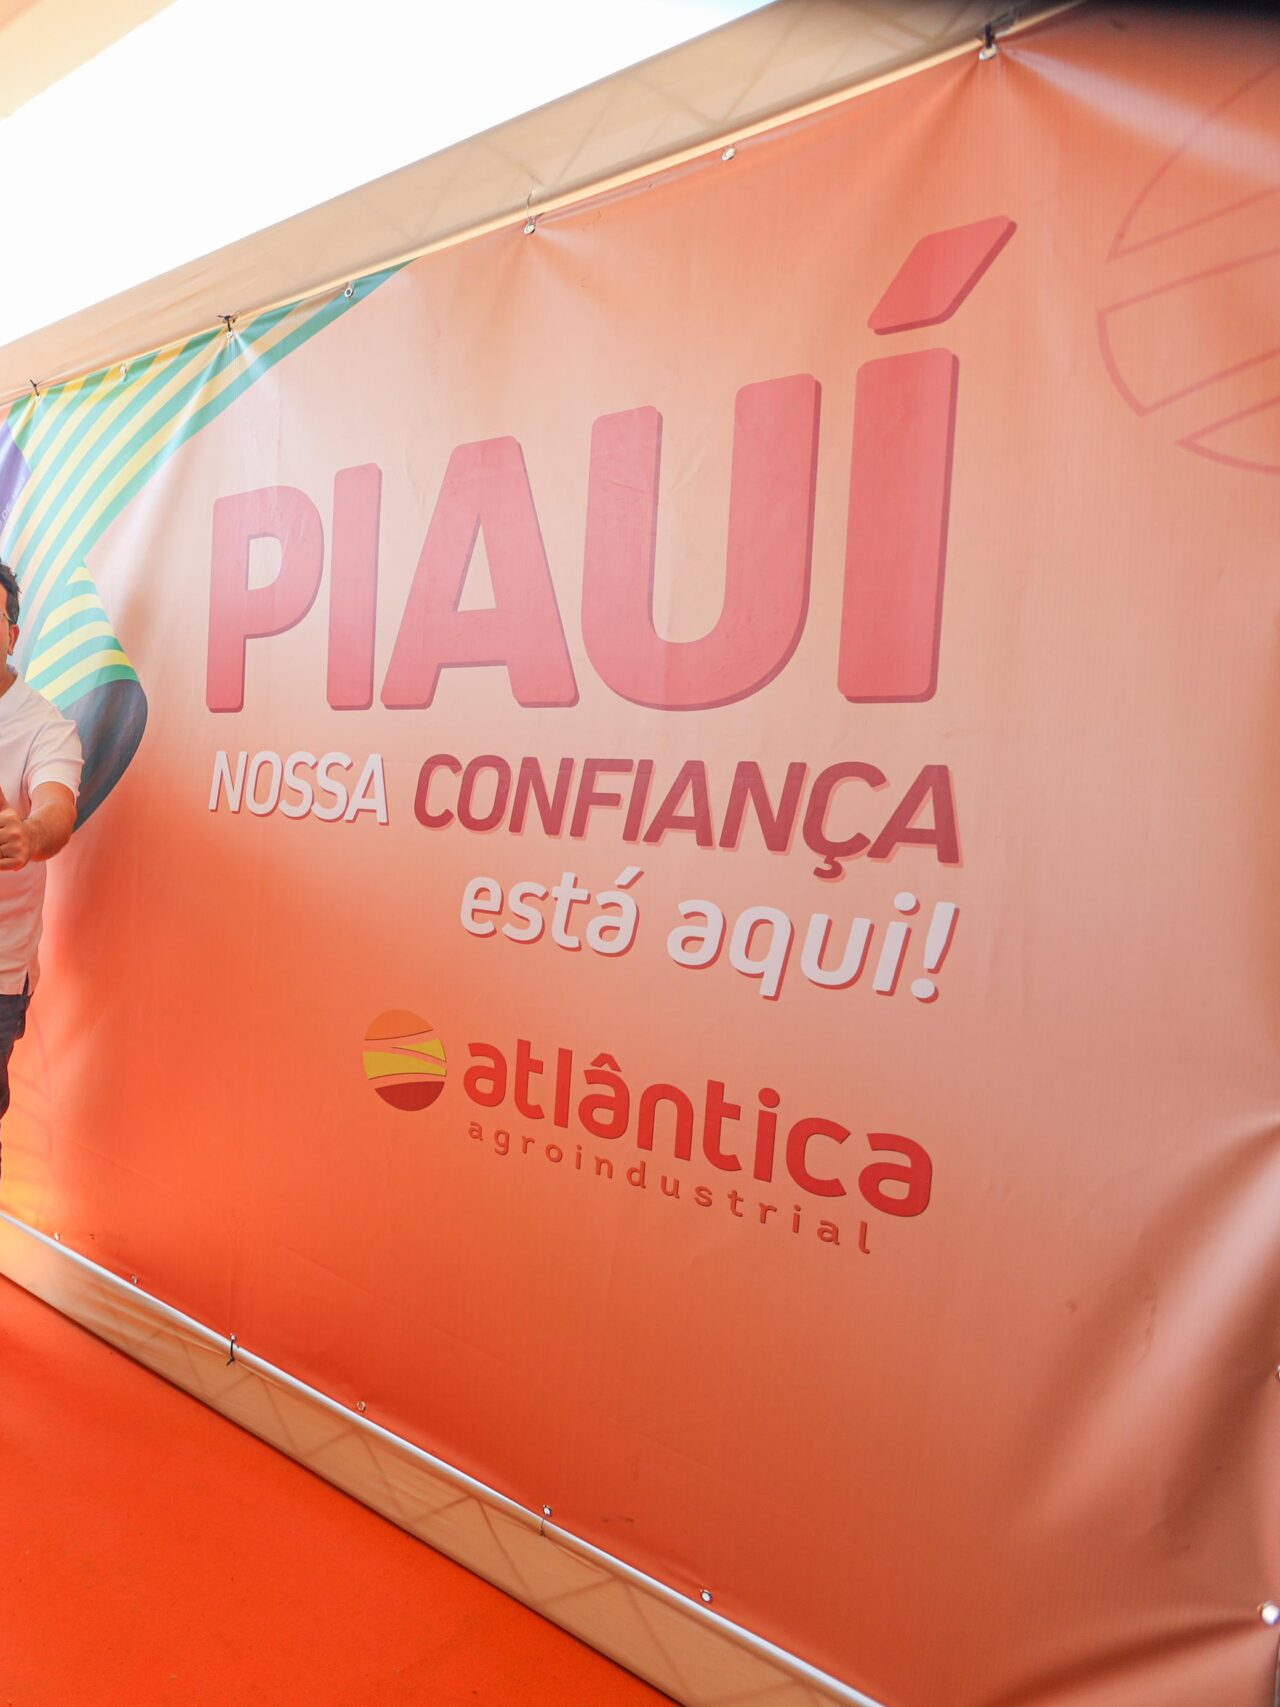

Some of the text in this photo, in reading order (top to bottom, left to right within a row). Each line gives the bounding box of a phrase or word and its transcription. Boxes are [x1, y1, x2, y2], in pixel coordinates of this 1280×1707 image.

[206, 215, 1018, 713] PIAUÍ
[208, 750, 962, 878] NOSSA CONFIANÇA
[460, 866, 960, 1003] está aqui!
[462, 1039, 934, 1218] atlântica
[467, 1121, 872, 1255] agroindustrial
